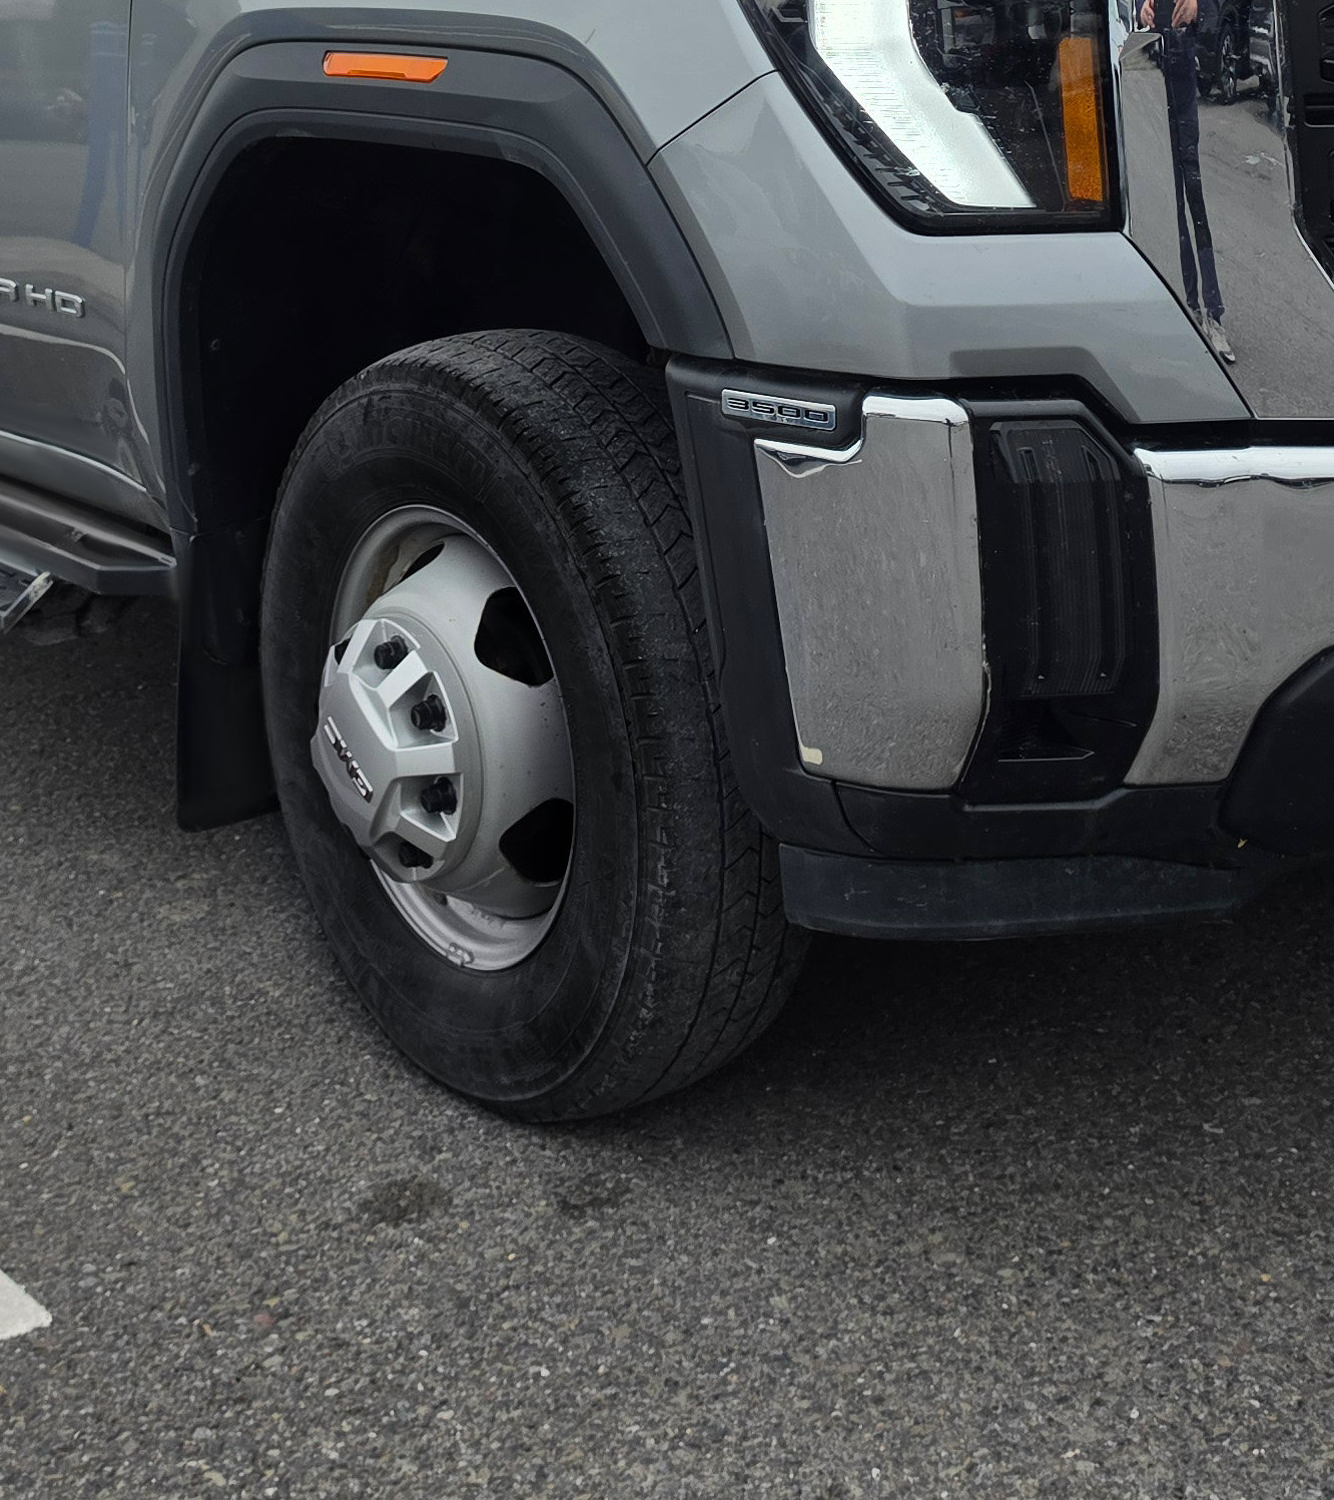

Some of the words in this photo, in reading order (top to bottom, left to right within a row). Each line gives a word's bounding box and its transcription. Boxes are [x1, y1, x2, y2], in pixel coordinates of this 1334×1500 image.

[25, 283, 86, 318] HD
[726, 396, 829, 424] 3500
[324, 715, 374, 804] GMC
